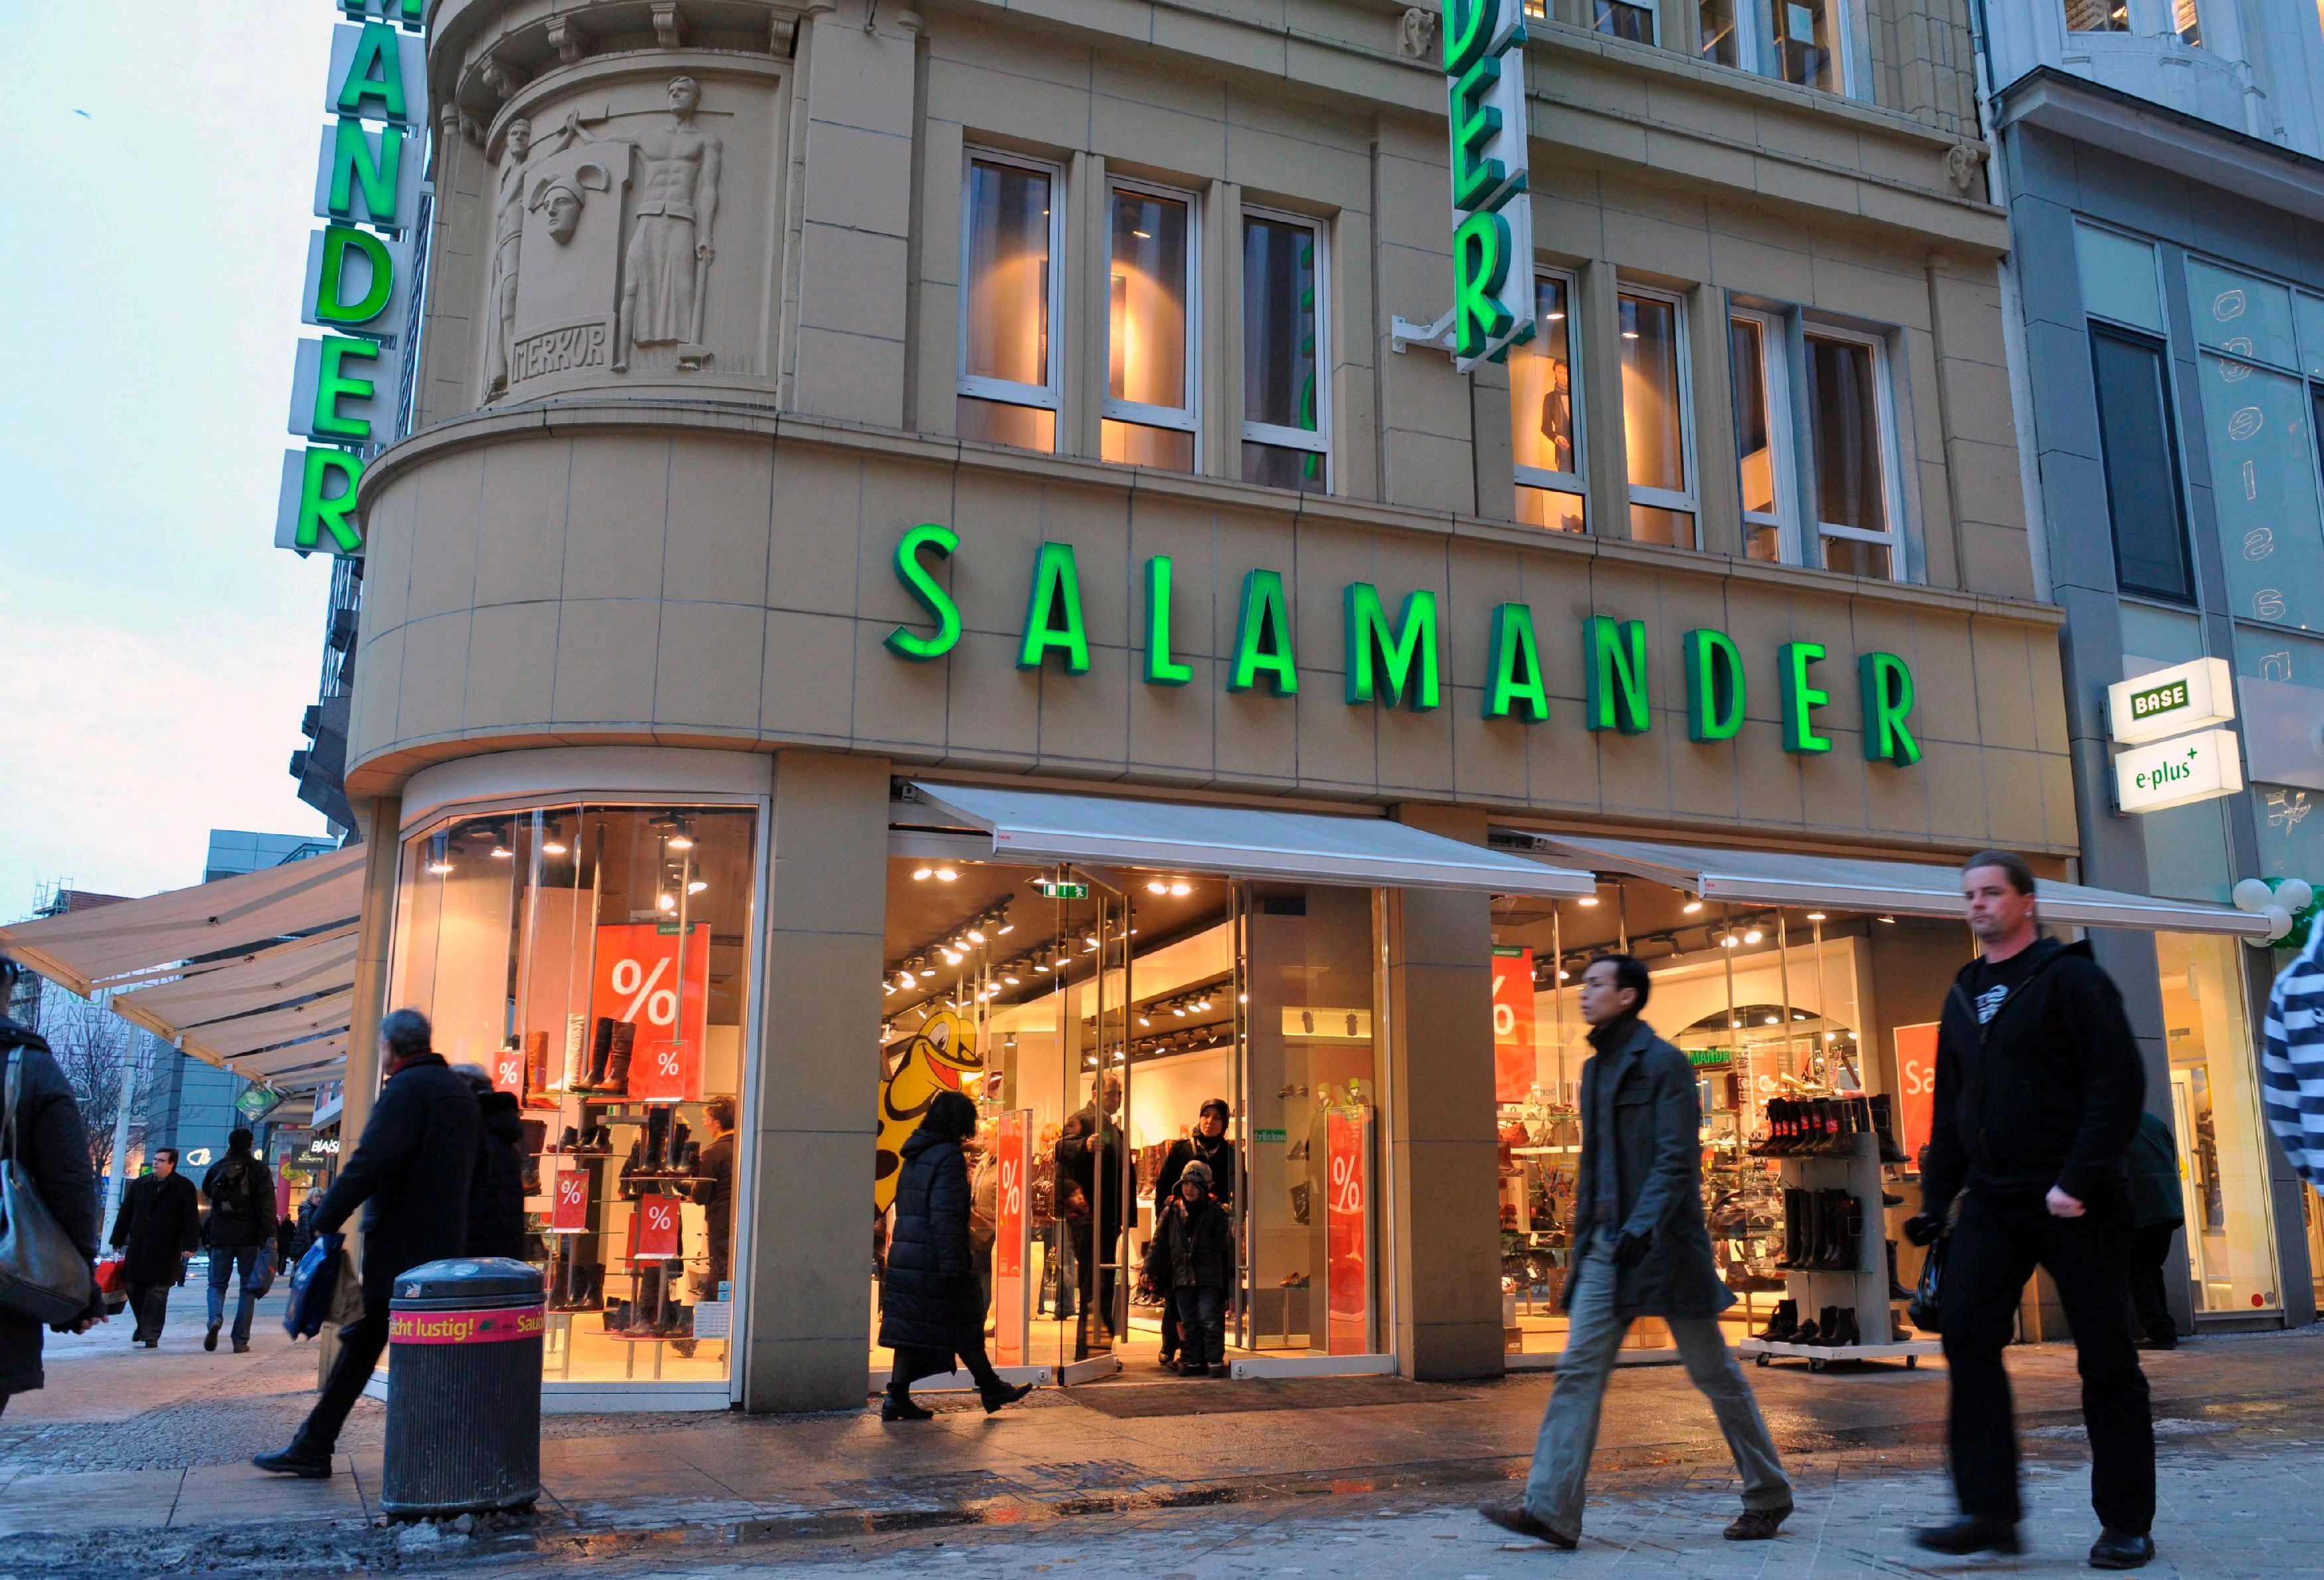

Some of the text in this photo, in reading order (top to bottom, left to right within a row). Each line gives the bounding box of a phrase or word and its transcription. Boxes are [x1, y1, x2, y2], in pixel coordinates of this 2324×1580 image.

[513, 325, 605, 384] MERKUR
[882, 523, 1923, 768] SALAMANDER
[2135, 686, 2185, 714] BASE
[612, 957, 677, 1025] %
[499, 1061, 517, 1085] %
[658, 1052, 679, 1076] %
[561, 1180, 581, 1205] %
[1002, 1158, 1020, 1216] %
[1333, 1154, 1360, 1212] %
[649, 1205, 671, 1230] %
[416, 1317, 475, 1341] lustig!
